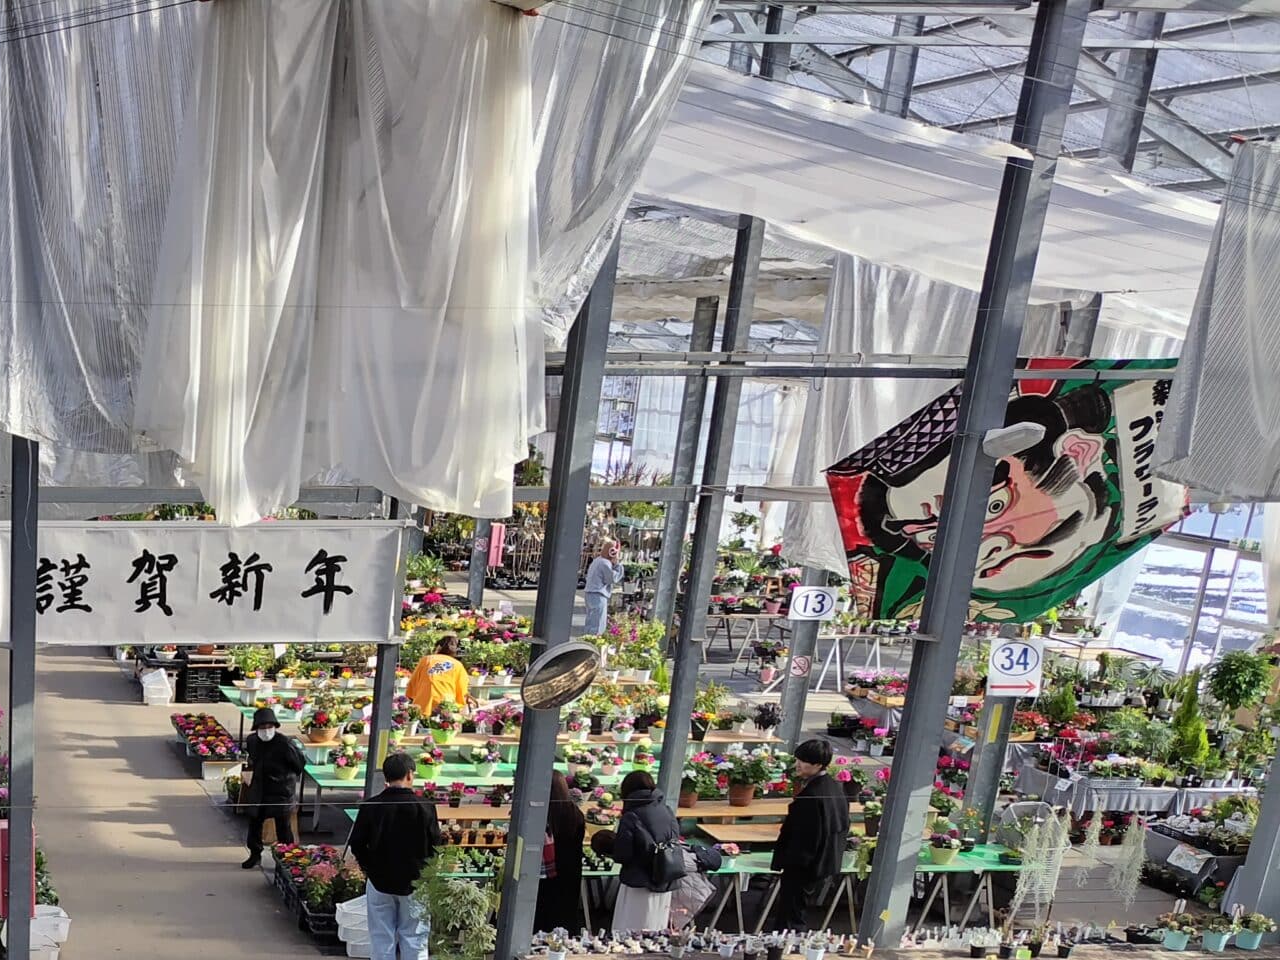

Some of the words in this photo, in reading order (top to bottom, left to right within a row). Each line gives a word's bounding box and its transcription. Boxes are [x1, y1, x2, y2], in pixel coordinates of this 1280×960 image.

[35, 548, 354, 617] 謹賀新年
[802, 593, 826, 614] 13
[1000, 647, 1030, 671] 34
